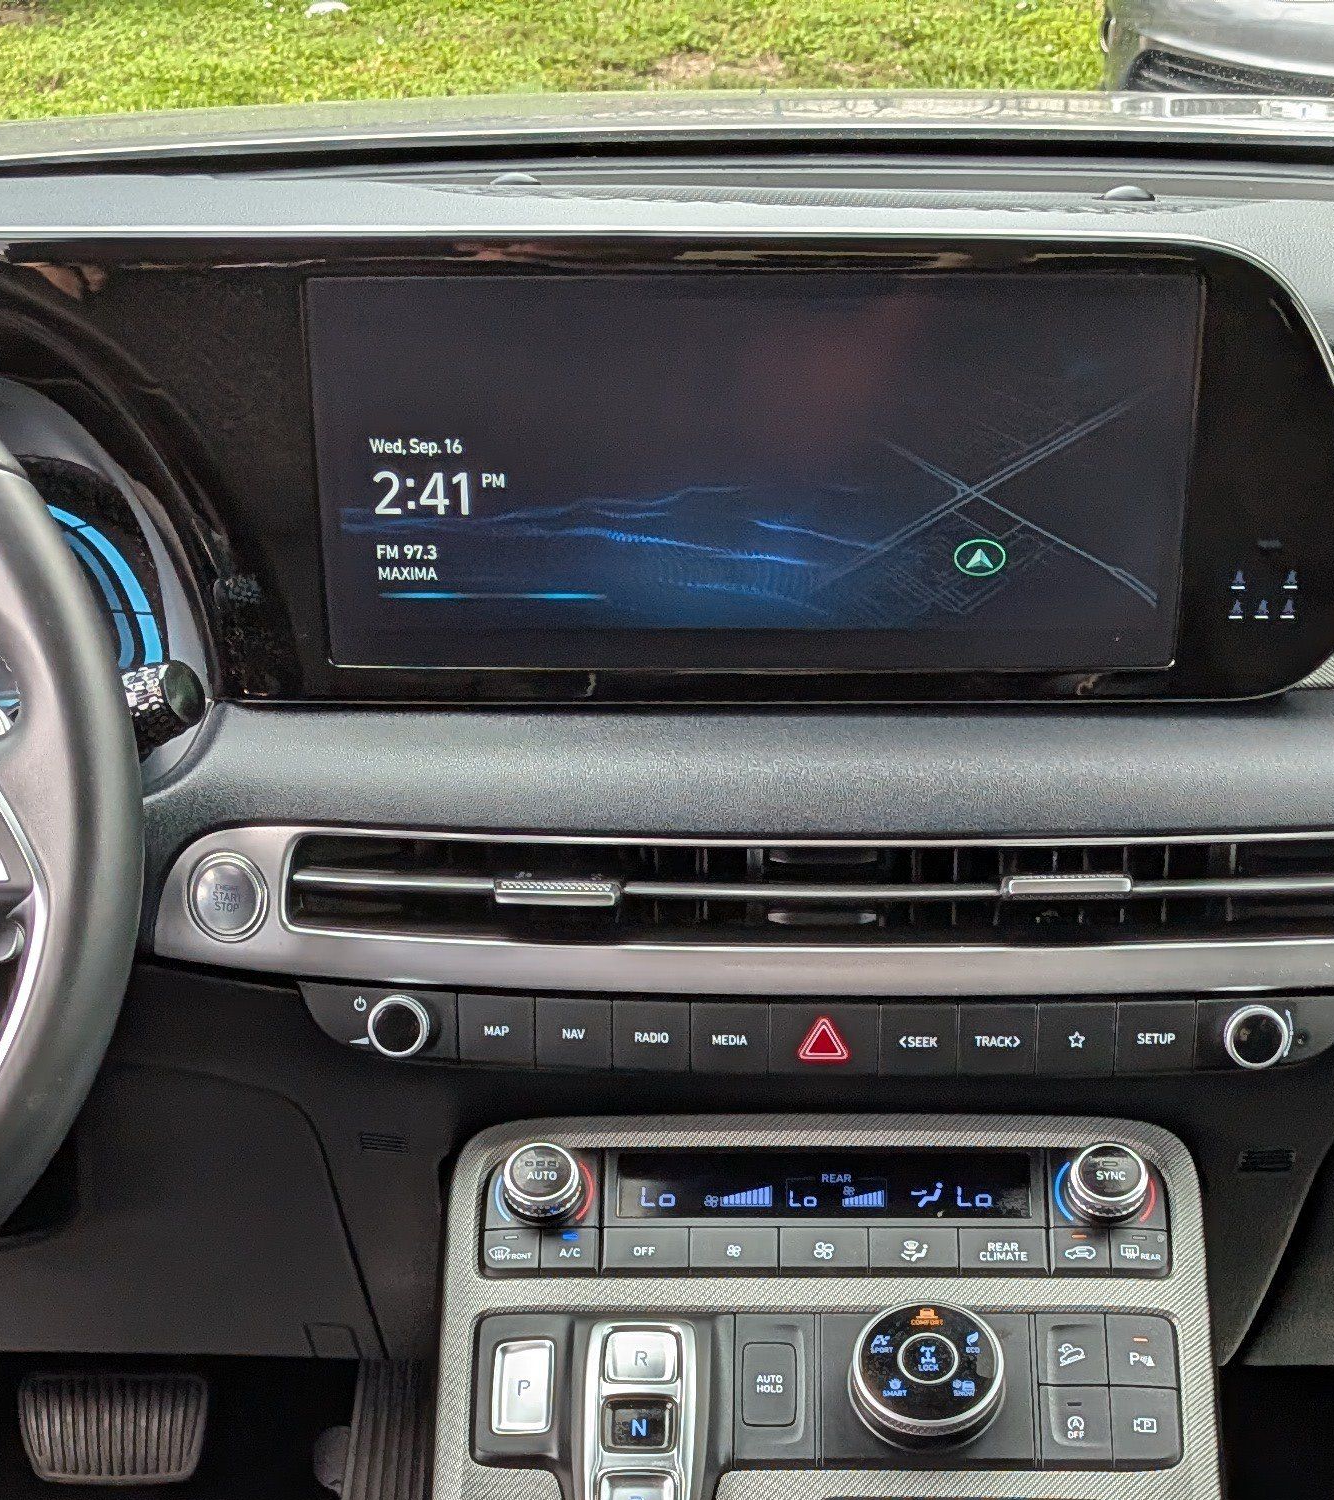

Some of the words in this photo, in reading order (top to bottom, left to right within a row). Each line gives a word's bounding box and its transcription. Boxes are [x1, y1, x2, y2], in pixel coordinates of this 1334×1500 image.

[369, 438, 407, 456] Wed,
[409, 438, 442, 457] Sep.
[444, 438, 463, 455] 16
[372, 470, 470, 516] 2:41
[481, 473, 506, 488] PM
[376, 544, 399, 560] FM
[403, 544, 438, 560] 97.3
[377, 566, 439, 581] MAXIMA
[212, 890, 241, 903] START
[214, 900, 240, 914] STOP
[483, 1025, 510, 1038] MAP
[561, 1028, 586, 1041] NAV
[633, 1031, 670, 1045] RADIO
[711, 1034, 748, 1047] MEDIA
[1136, 1032, 1176, 1046] SETUP
[526, 1170, 558, 1181] AUTO
[821, 1173, 852, 1184] REAR
[1095, 1170, 1127, 1182] SYNC
[640, 1187, 676, 1208] Lo
[788, 1190, 818, 1208] Lo
[956, 1186, 993, 1208] Lo
[558, 1247, 581, 1259] A/C
[633, 1246, 656, 1257] OFF
[987, 1242, 1019, 1252] REAR
[507, 1251, 532, 1261] FRONT
[979, 1251, 1029, 1263] CLIMATE
[1140, 1252, 1162, 1262] REAR
[965, 1346, 981, 1354] ECO
[634, 1350, 648, 1367] R
[917, 1364, 939, 1372] LOCK
[756, 1374, 784, 1384] AUTO
[517, 1379, 531, 1397] P
[756, 1384, 784, 1394] HOLD
[882, 1389, 908, 1398] SMART
[630, 1418, 647, 1437] N
[1067, 1431, 1085, 1439] OFF
